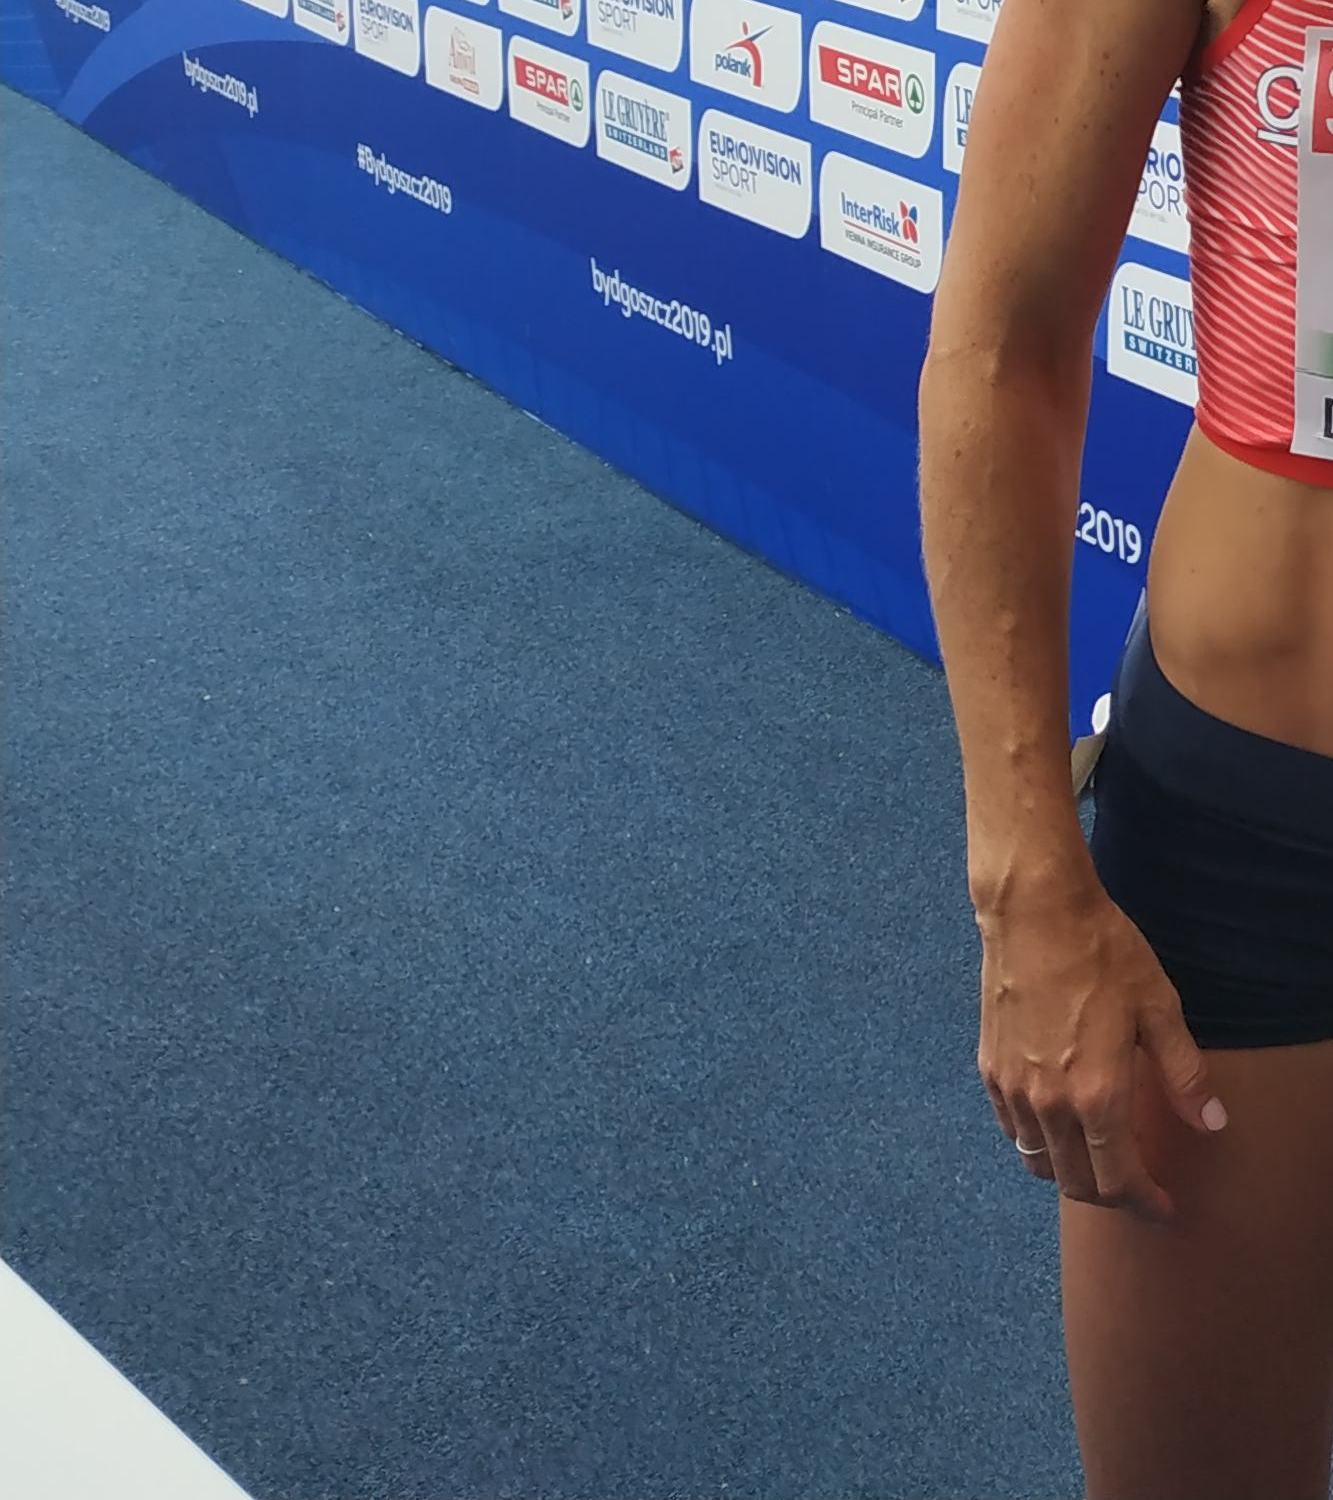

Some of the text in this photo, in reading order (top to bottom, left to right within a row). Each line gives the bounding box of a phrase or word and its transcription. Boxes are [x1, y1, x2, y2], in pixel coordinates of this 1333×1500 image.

[598, 2, 638, 34] SPORT
[525, 64, 567, 101] SPAR
[715, 53, 752, 78] polanik
[837, 58, 901, 101] SPAR
[601, 88, 617, 121] LE
[605, 124, 668, 161] SWITZERLAND
[712, 159, 758, 195] SPORT
[841, 191, 901, 238] InterRisk
[590, 256, 733, 366] bydgoszcz2019.pl
[1121, 285, 1146, 332] LE
